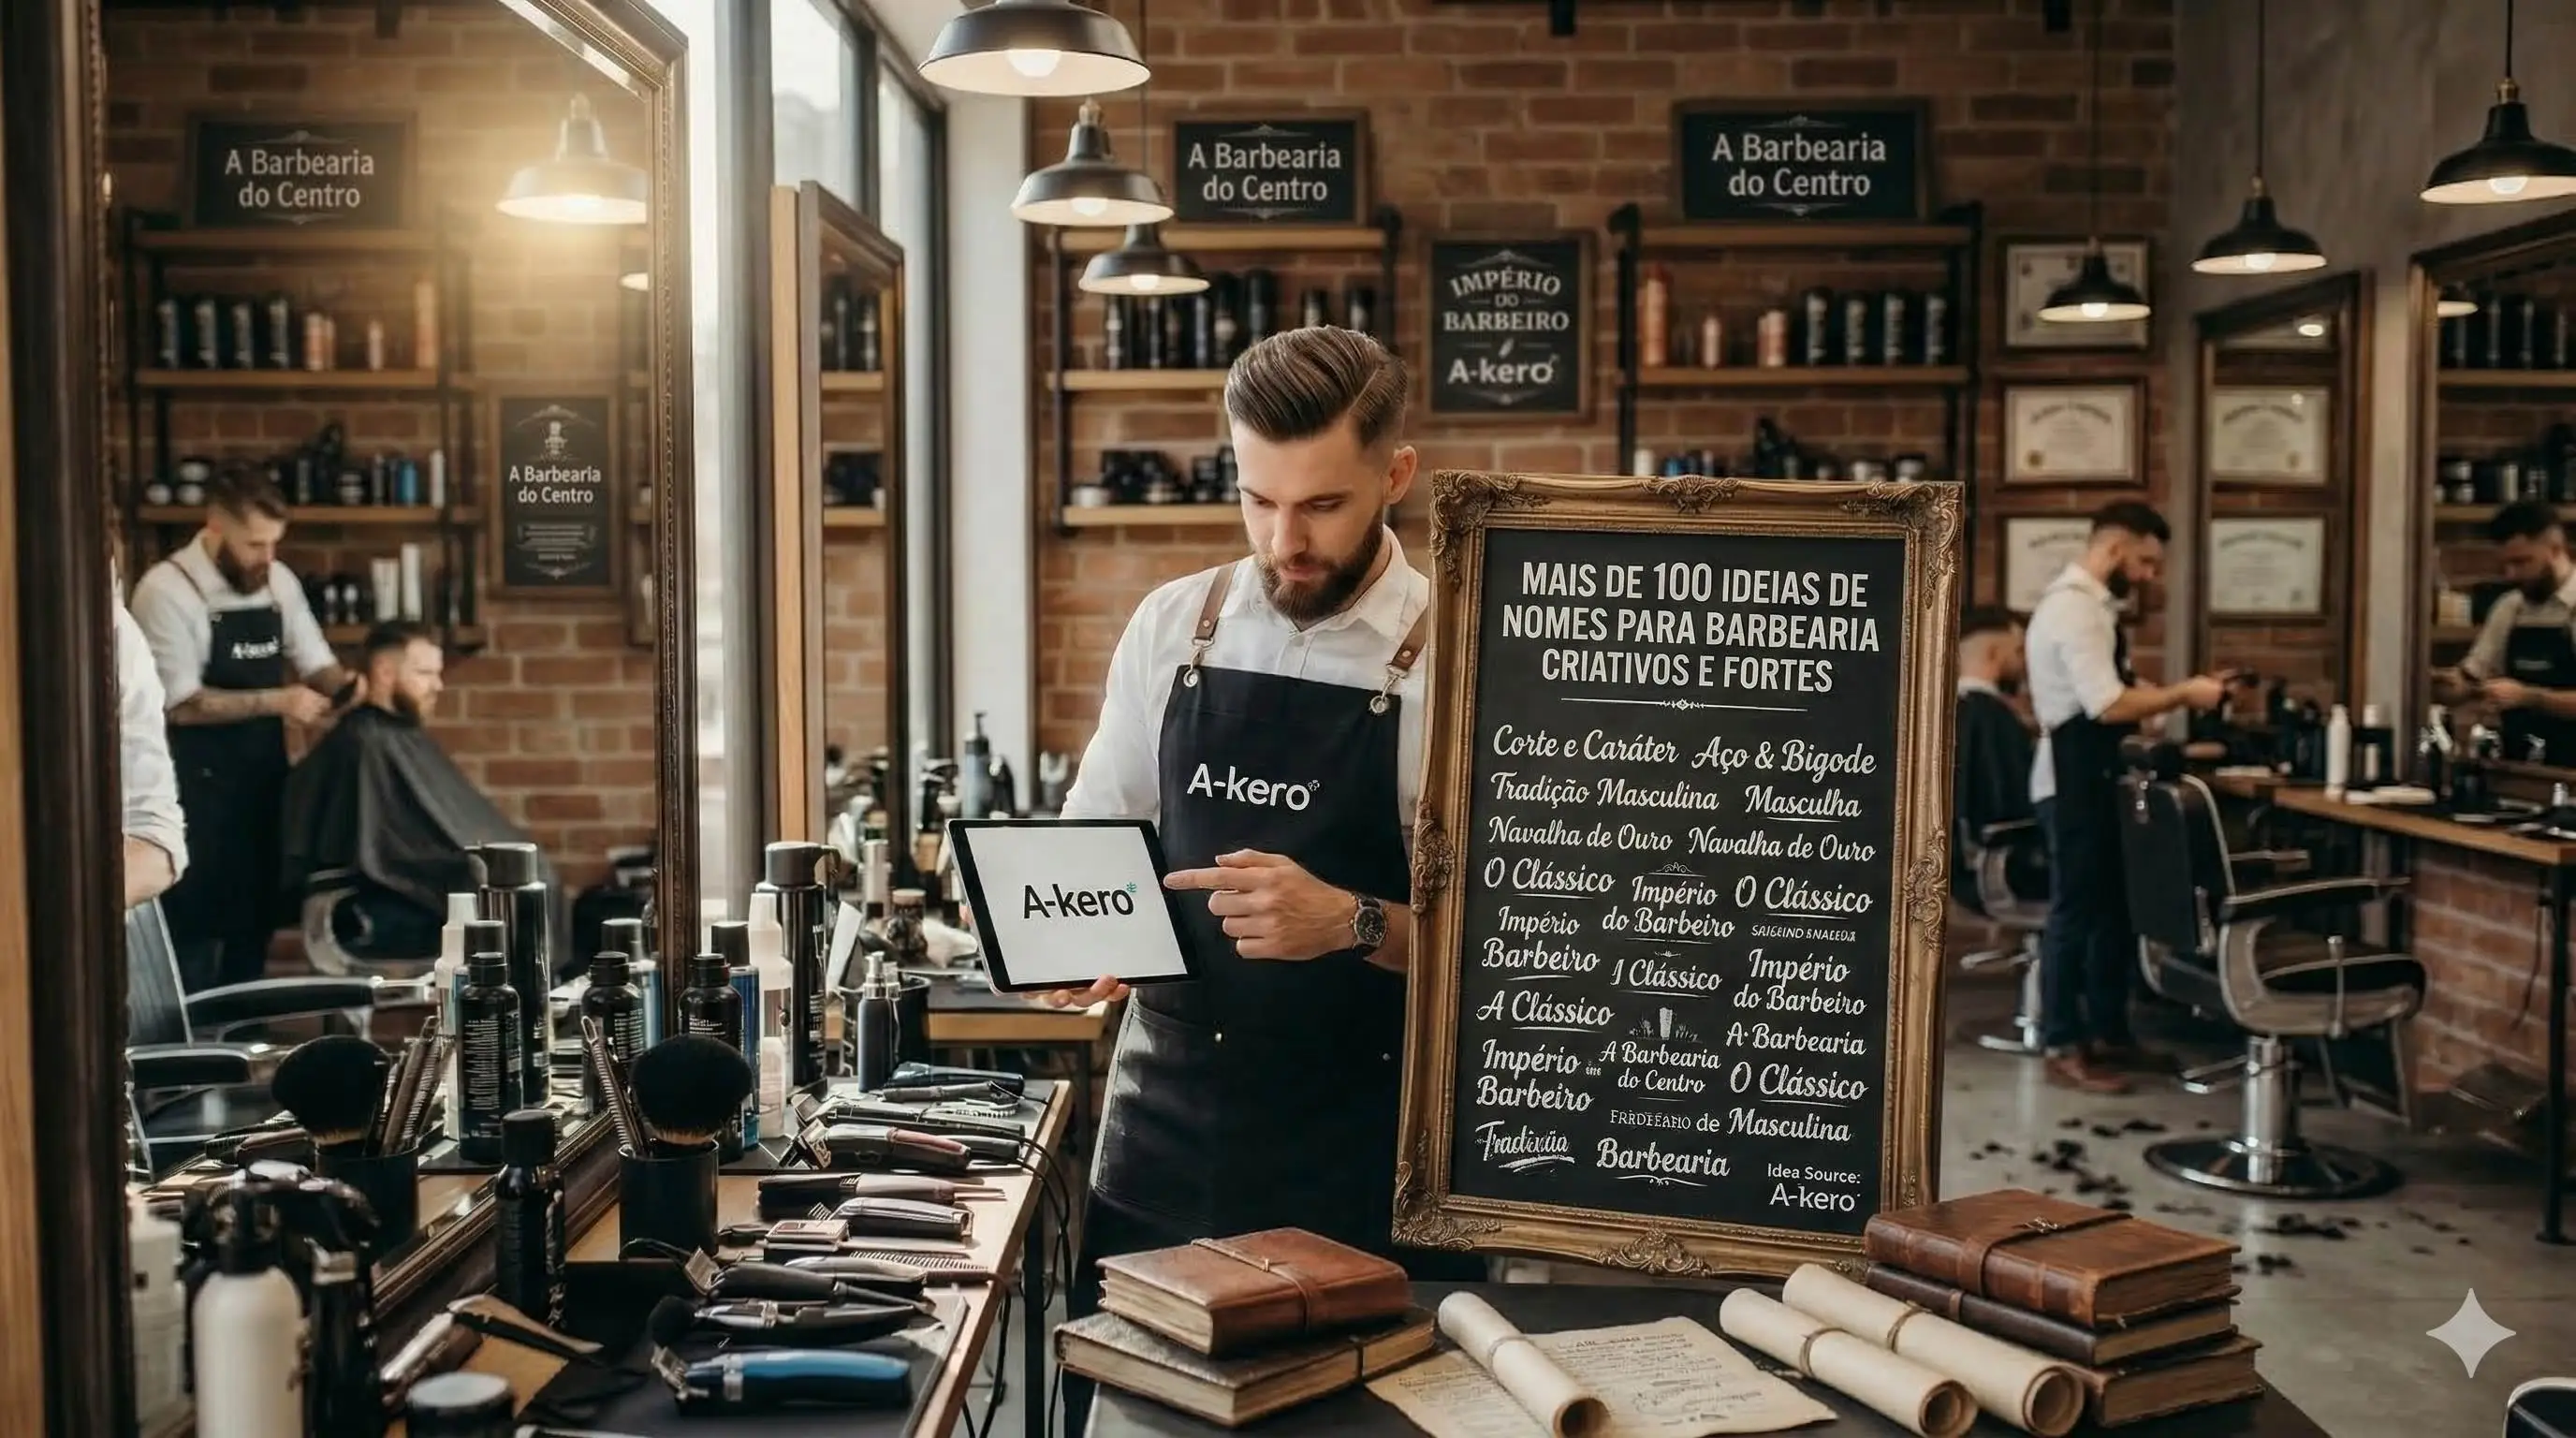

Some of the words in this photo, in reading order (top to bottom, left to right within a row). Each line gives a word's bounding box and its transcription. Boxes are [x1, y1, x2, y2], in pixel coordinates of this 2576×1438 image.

[226, 150, 242, 175] A
[252, 148, 374, 175] Barbearia
[1188, 142, 1208, 169] A
[1215, 140, 1341, 169] Barbearia
[1712, 134, 1733, 163] A
[1743, 132, 1886, 163] Barbearia
[239, 183, 270, 208] do
[277, 182, 360, 208] Centro
[1203, 174, 1234, 201] do
[1242, 175, 1327, 201] Centro
[1728, 167, 1763, 198] do
[1773, 169, 1871, 198] Centro
[1451, 266, 1560, 298] IMPÉRIO
[1443, 311, 1570, 330] BARBEIRO
[1448, 358, 1554, 385] A-kero
[509, 466, 520, 482] A
[524, 465, 601, 483] Barbearia
[518, 486, 538, 503] do
[541, 486, 593, 504] Centro
[1522, 563, 1596, 597] MAIS
[1606, 565, 1643, 598] DE
[1653, 563, 1712, 602] 100
[1722, 569, 1821, 606] IDEIAS
[1829, 573, 1868, 608] DE
[1502, 605, 1608, 641] NOMES
[1617, 609, 1695, 644] PARA
[1706, 612, 1880, 652] BARBEARIA
[1542, 648, 1689, 686] CRIATIVOS
[1699, 655, 1713, 687] E
[1723, 656, 1833, 693] FORTES
[1493, 725, 1559, 756] Corte
[1565, 740, 1576, 756] e
[1583, 729, 1679, 764] Caráter
[1691, 736, 1750, 773] Aço
[1755, 741, 1774, 769] &
[1781, 740, 1876, 784] Bigode
[1187, 763, 1310, 811] A-kero
[1491, 771, 1589, 809] Tradição
[1597, 778, 1719, 811] Masculina
[1745, 785, 1863, 816] Masculha
[1489, 816, 1582, 847] Navalha
[1587, 822, 1612, 848] de
[1617, 824, 1673, 850] Ouro
[1689, 827, 1783, 858] Navalha
[1788, 834, 1814, 858] de
[1819, 834, 1876, 861] Ouro
[1484, 858, 1505, 888] O
[1512, 858, 1615, 892] Clássico
[1023, 884, 1134, 919] A-kero
[1632, 874, 1719, 910] Império
[1735, 875, 1756, 908] O
[1764, 876, 1873, 913] Clássico
[1499, 906, 1580, 938] Império
[1603, 906, 1630, 931] do
[1633, 907, 1735, 938] Barbeiro
[1482, 938, 1600, 973] Barbeiro
[1749, 948, 1851, 990] Império
[1629, 959, 1722, 990] Clássico
[1476, 990, 1505, 1022] A
[1511, 990, 1615, 1025] Clássico
[1734, 984, 1762, 1009] do
[1765, 986, 1867, 1015] Barbeiro
[1752, 1022, 1866, 1055] Barbearia
[1483, 1039, 1581, 1079] Império
[1599, 1043, 1617, 1062] A
[1622, 1042, 1720, 1070] Barbearia
[1476, 1076, 1593, 1112] Barbeiro
[1617, 1069, 1641, 1089] do
[1645, 1068, 1705, 1093] Centro
[1730, 1062, 1751, 1094] O
[1759, 1063, 1868, 1101] Clássico
[1696, 1113, 1720, 1133] de
[1727, 1108, 1851, 1142] Masculina
[1597, 1137, 1730, 1177] Barbearia
[1768, 1163, 1800, 1179] Idea
[1805, 1167, 1861, 1184] Source:
[1769, 1182, 1855, 1211] A-kero
